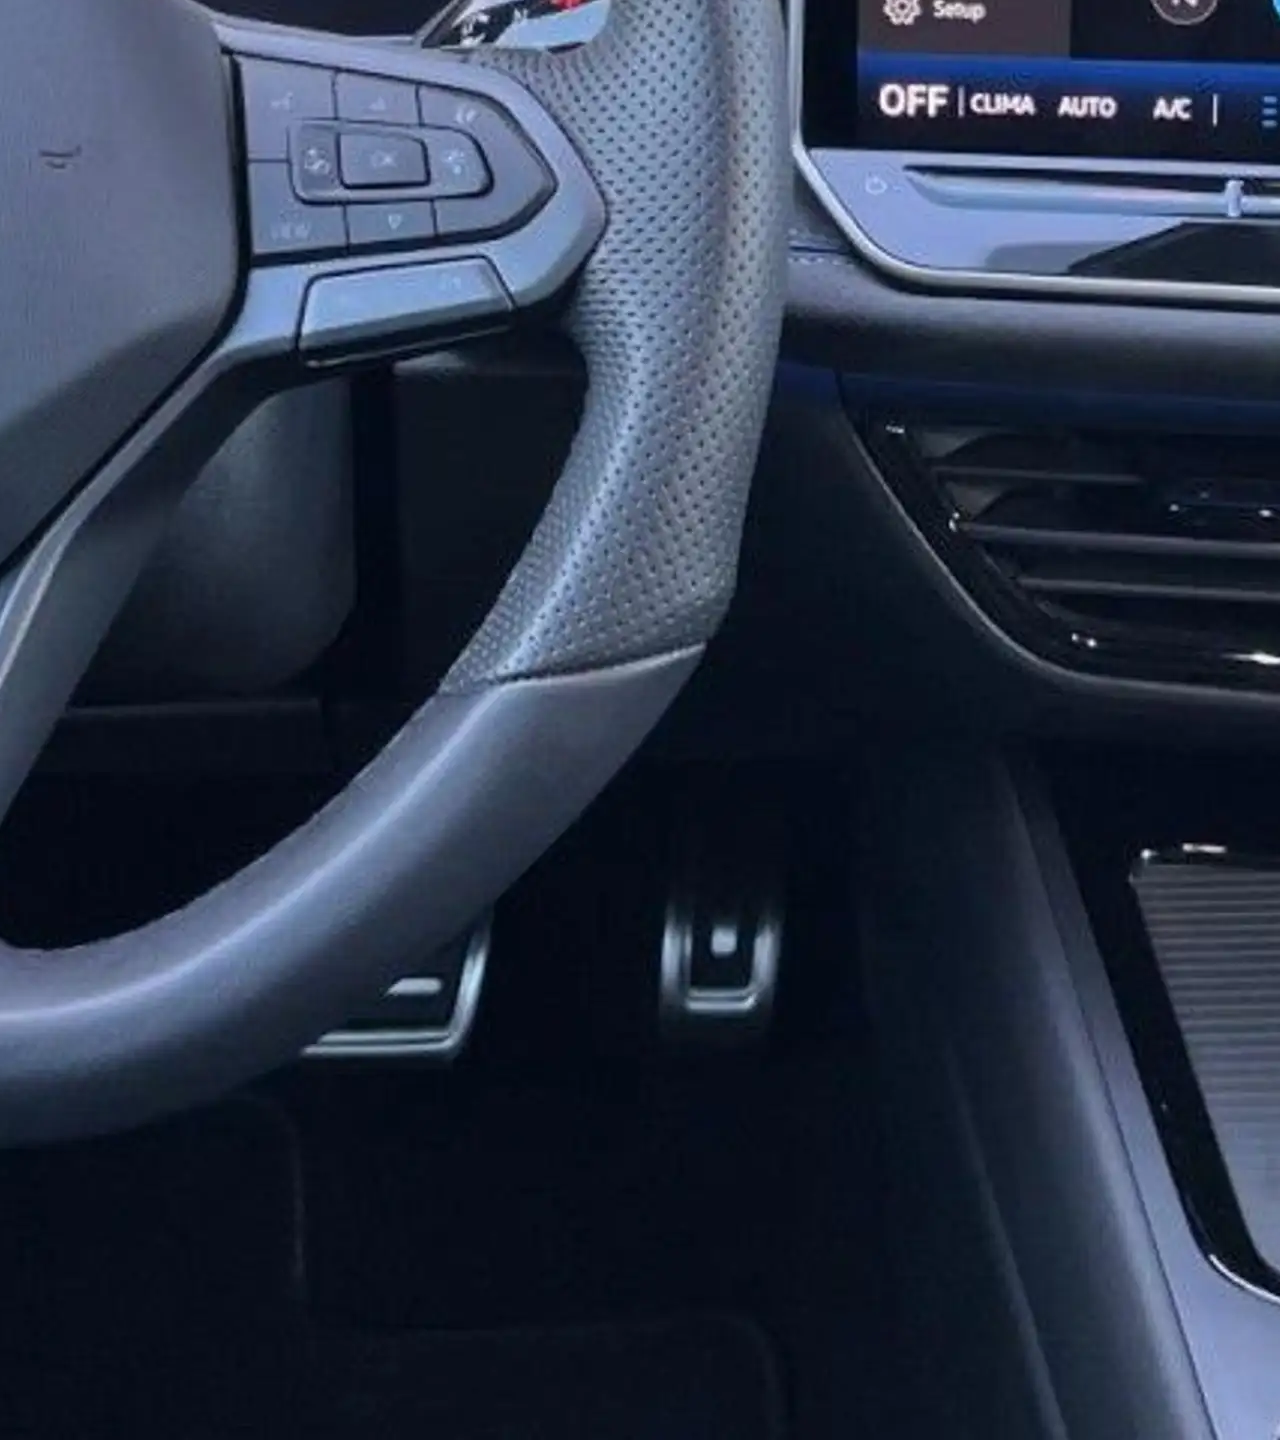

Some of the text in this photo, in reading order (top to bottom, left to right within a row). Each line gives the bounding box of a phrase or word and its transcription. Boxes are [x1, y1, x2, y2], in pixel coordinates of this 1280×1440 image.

[879, 83, 1193, 120] OFF CLIMA AUTO A/C
